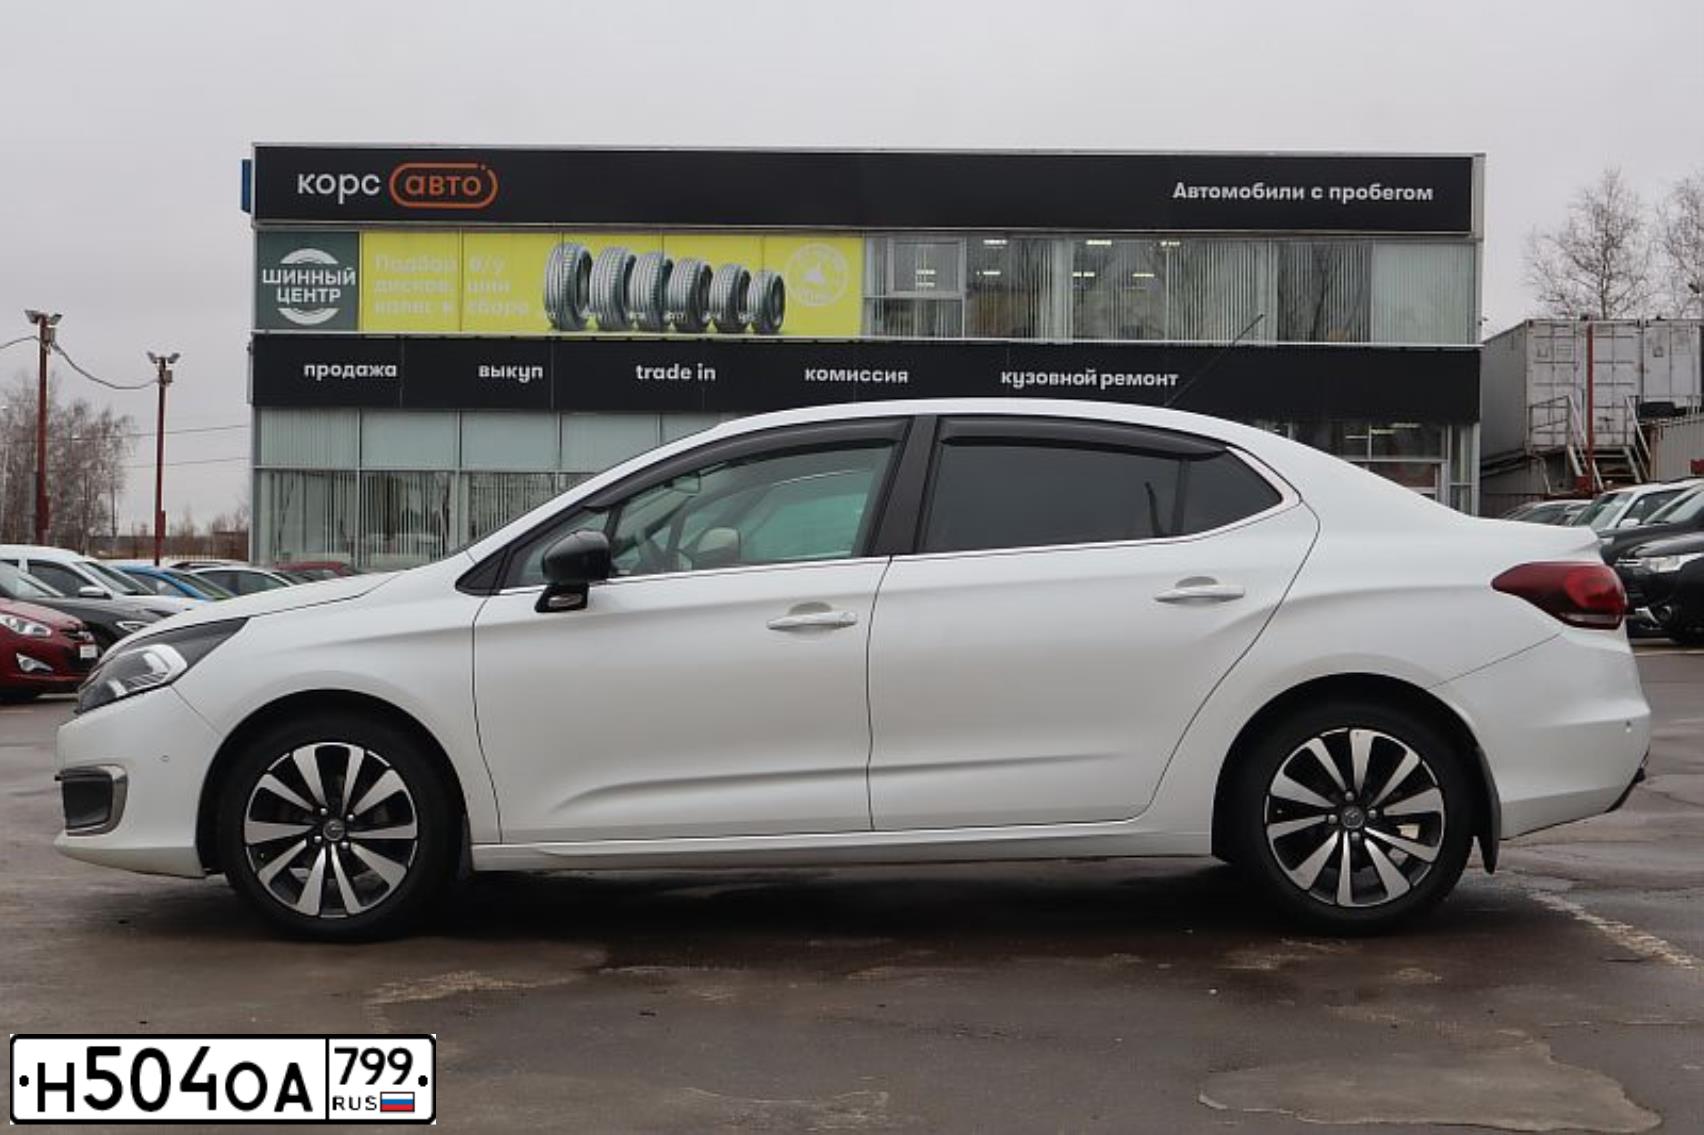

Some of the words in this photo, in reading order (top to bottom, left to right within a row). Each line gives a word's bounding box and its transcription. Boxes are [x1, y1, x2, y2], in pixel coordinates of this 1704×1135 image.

[297, 173, 381, 205] корс
[405, 175, 482, 196] авто
[1172, 181, 1305, 200] Автомобили
[1310, 186, 1324, 200] с
[1329, 182, 1434, 204] пробегом
[262, 266, 356, 286] ШИННЫЙ
[276, 287, 342, 305] ЦЕНТР
[303, 363, 398, 381] продажа
[478, 365, 544, 384] выкуп
[635, 363, 693, 381] trade
[697, 363, 717, 381] in
[804, 367, 909, 384] комиссия
[1000, 369, 1098, 389] кузовной
[1100, 372, 1179, 391] ремонт
